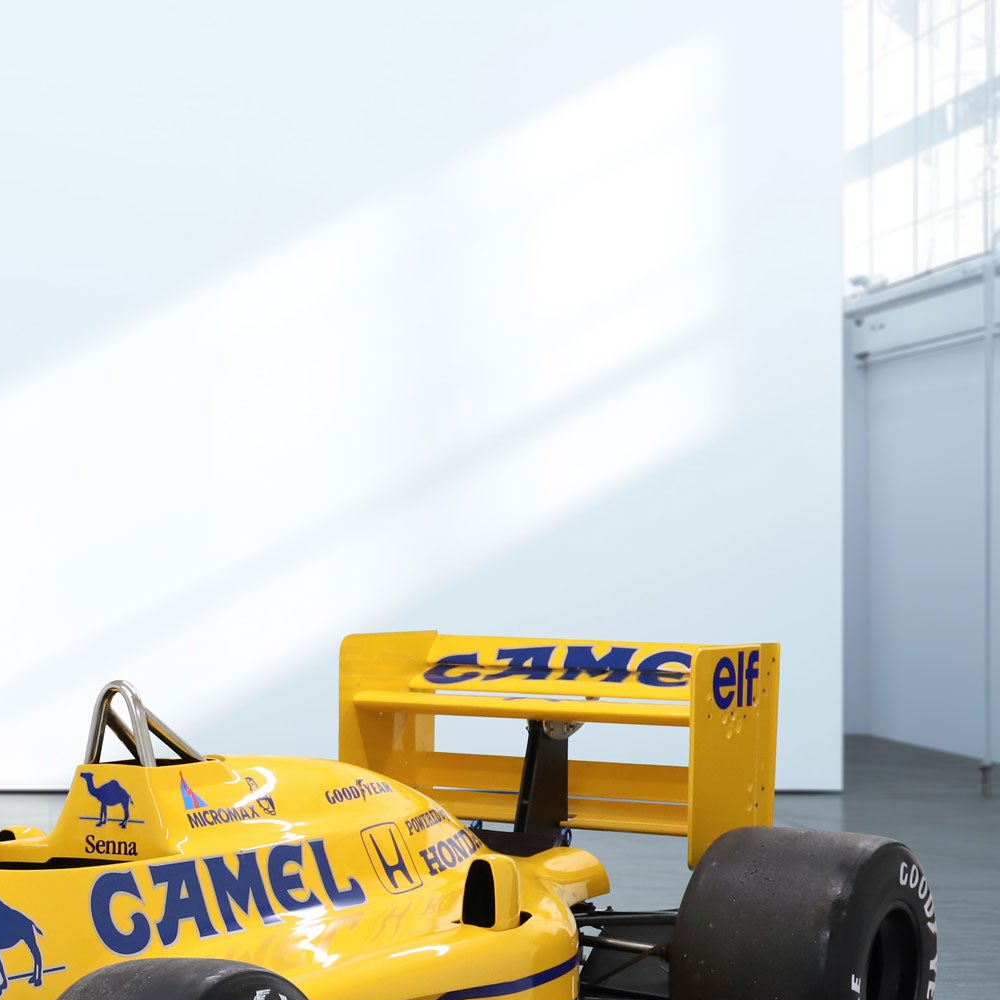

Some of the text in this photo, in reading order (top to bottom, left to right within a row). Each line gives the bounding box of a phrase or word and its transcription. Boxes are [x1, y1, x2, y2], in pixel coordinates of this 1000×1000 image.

[423, 645, 691, 687] CAME
[713, 650, 759, 710] elf
[187, 805, 260, 828] MICROMAX
[405, 809, 442, 836] POWERED
[85, 835, 138, 856] Senna
[419, 829, 482, 876] HONDA
[89, 838, 367, 956] CAMEL
